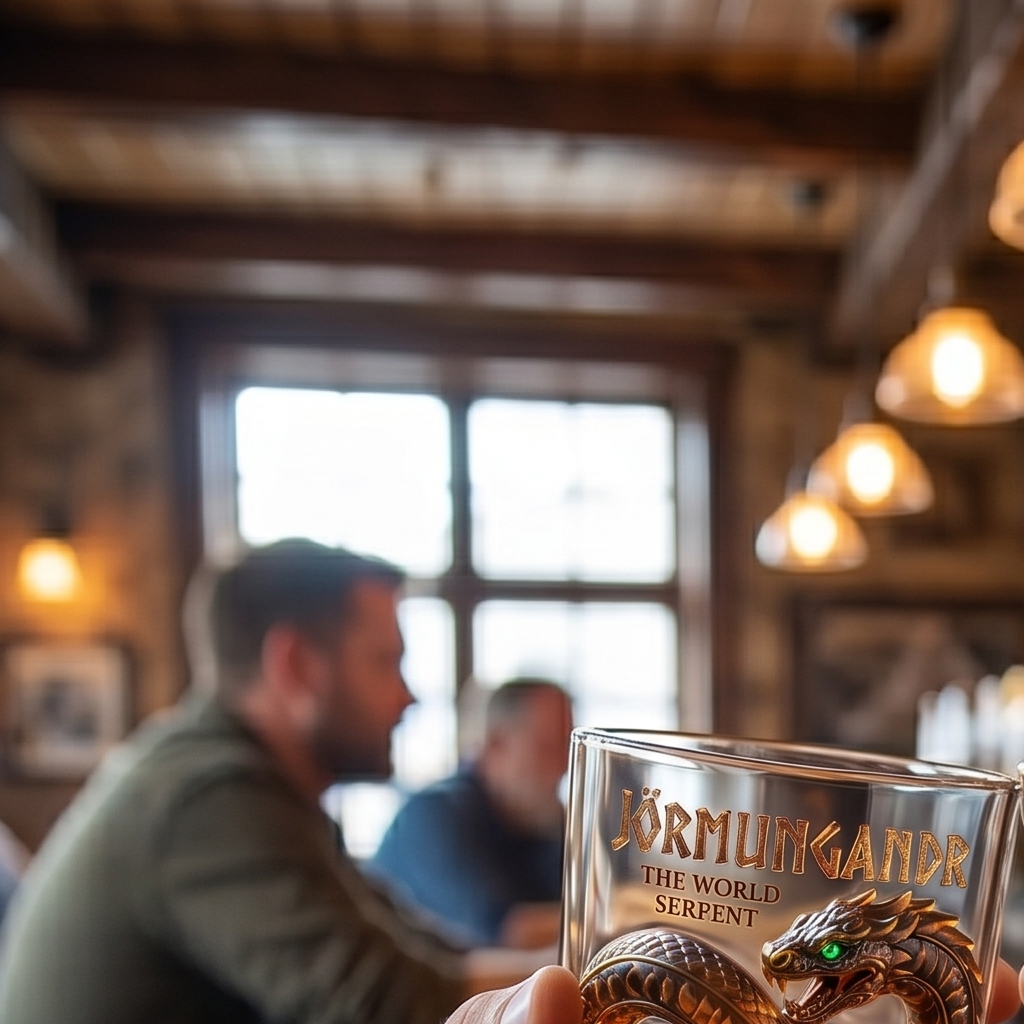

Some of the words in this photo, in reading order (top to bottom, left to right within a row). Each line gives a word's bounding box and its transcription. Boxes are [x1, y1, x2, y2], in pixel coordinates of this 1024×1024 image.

[611, 787, 970, 888] JÖRMUNGANDR
[641, 864, 686, 891] THE
[692, 874, 780, 904] WORLD
[655, 894, 759, 928] SERPENT
